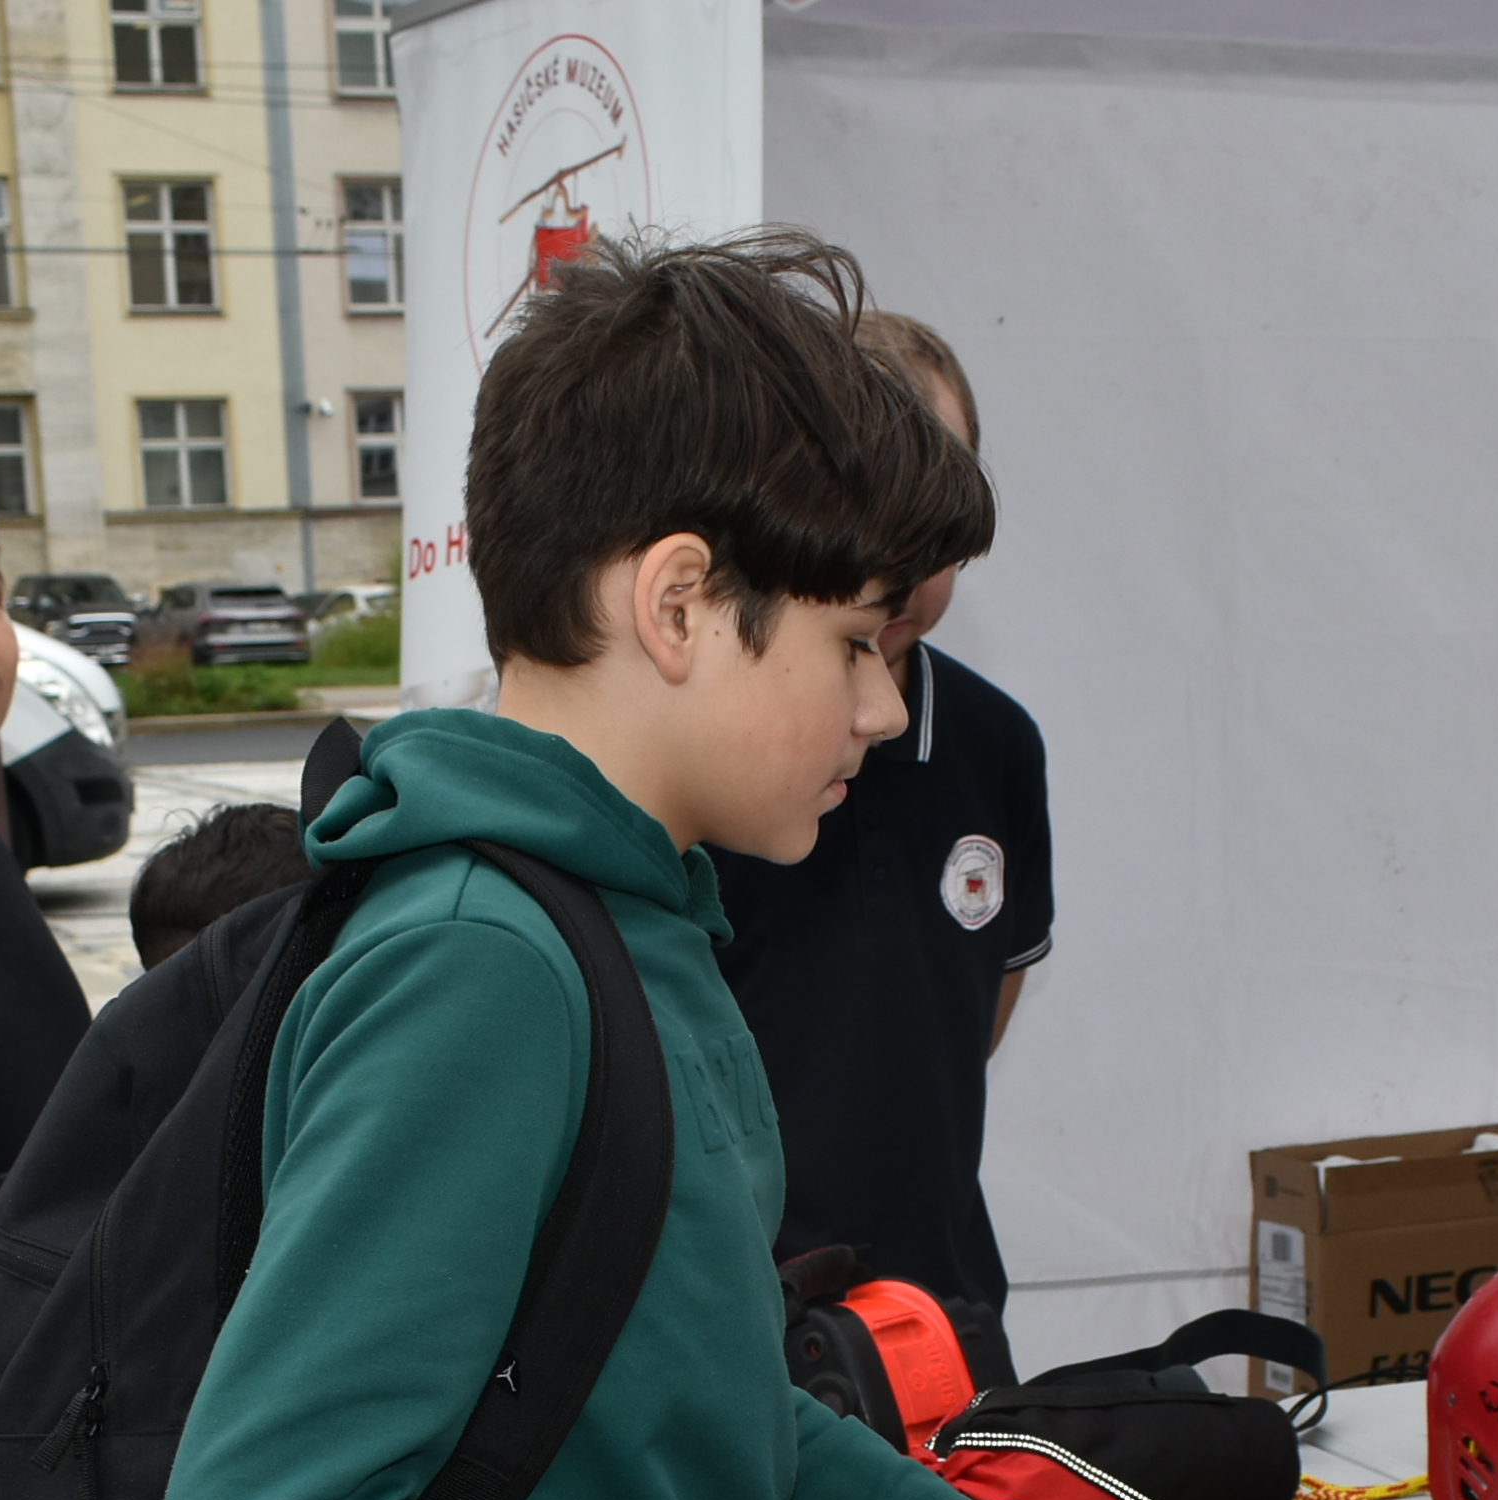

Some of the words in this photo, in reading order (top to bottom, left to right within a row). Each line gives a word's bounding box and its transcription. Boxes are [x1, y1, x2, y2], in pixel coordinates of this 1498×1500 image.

[496, 53, 559, 158] HASIČSKÉ
[566, 57, 624, 128] MUZEUM
[409, 537, 436, 579] Do
[445, 521, 467, 567] H
[1368, 1265, 1498, 1319] NEC
